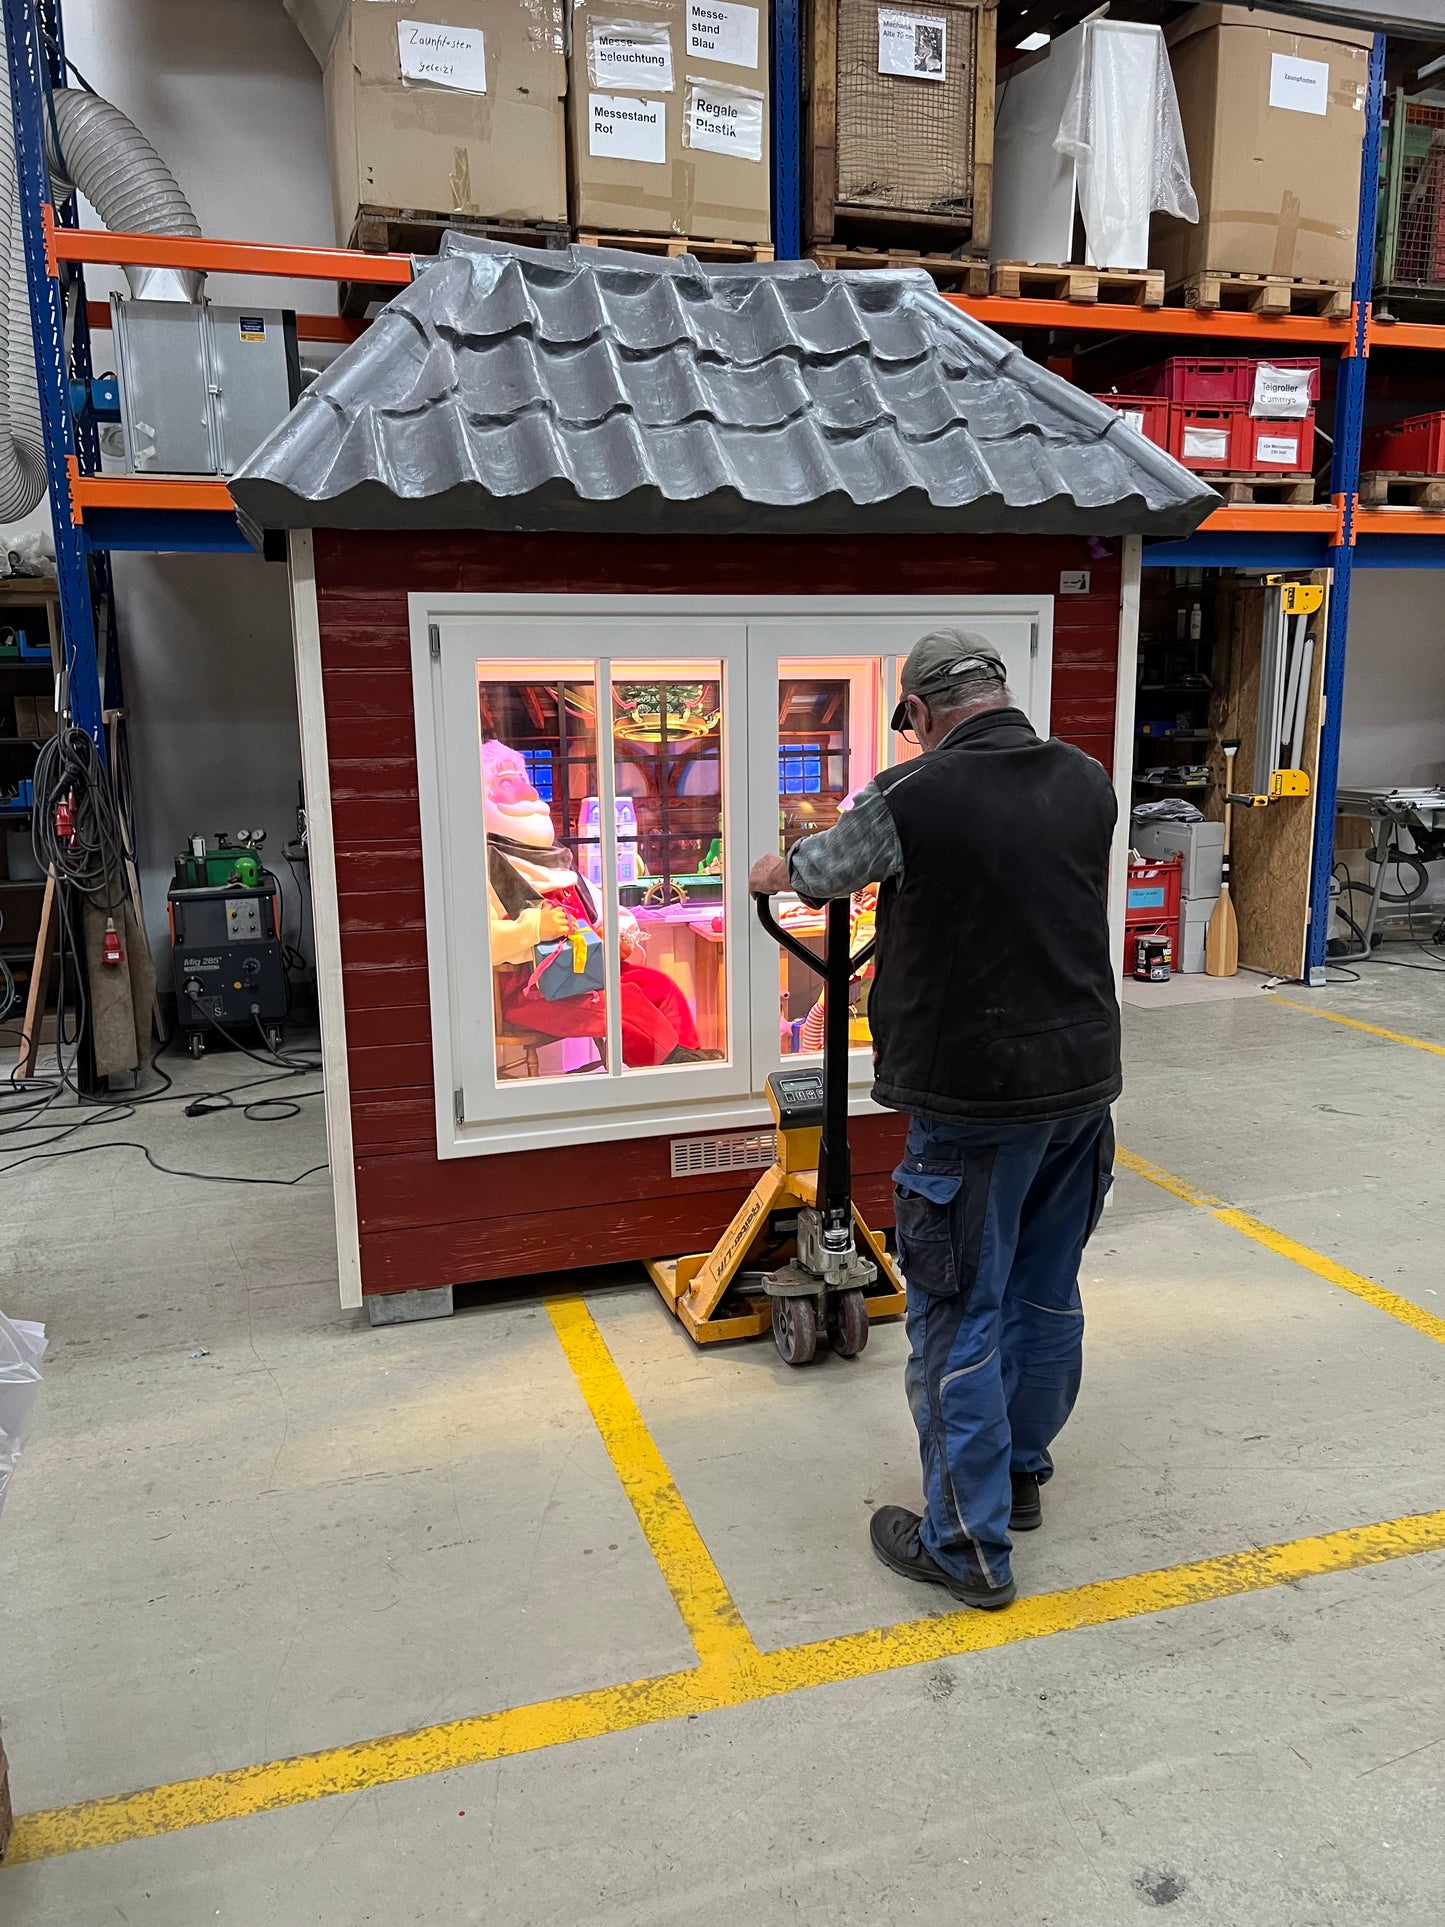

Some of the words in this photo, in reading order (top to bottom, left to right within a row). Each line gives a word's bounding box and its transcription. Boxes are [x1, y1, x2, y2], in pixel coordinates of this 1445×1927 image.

[691, 5, 728, 20] Messe-
[691, 23, 720, 35] stand
[883, 21, 912, 30] Mechank
[599, 36, 637, 48] Messe-
[691, 36, 715, 50] Blau
[600, 51, 665, 67] beleuchtung
[594, 106, 657, 124] Messestand
[696, 98, 738, 118] Regale
[594, 122, 614, 134] Rot
[696, 118, 737, 138] Plastik
[202, 956, 219, 965] 285
